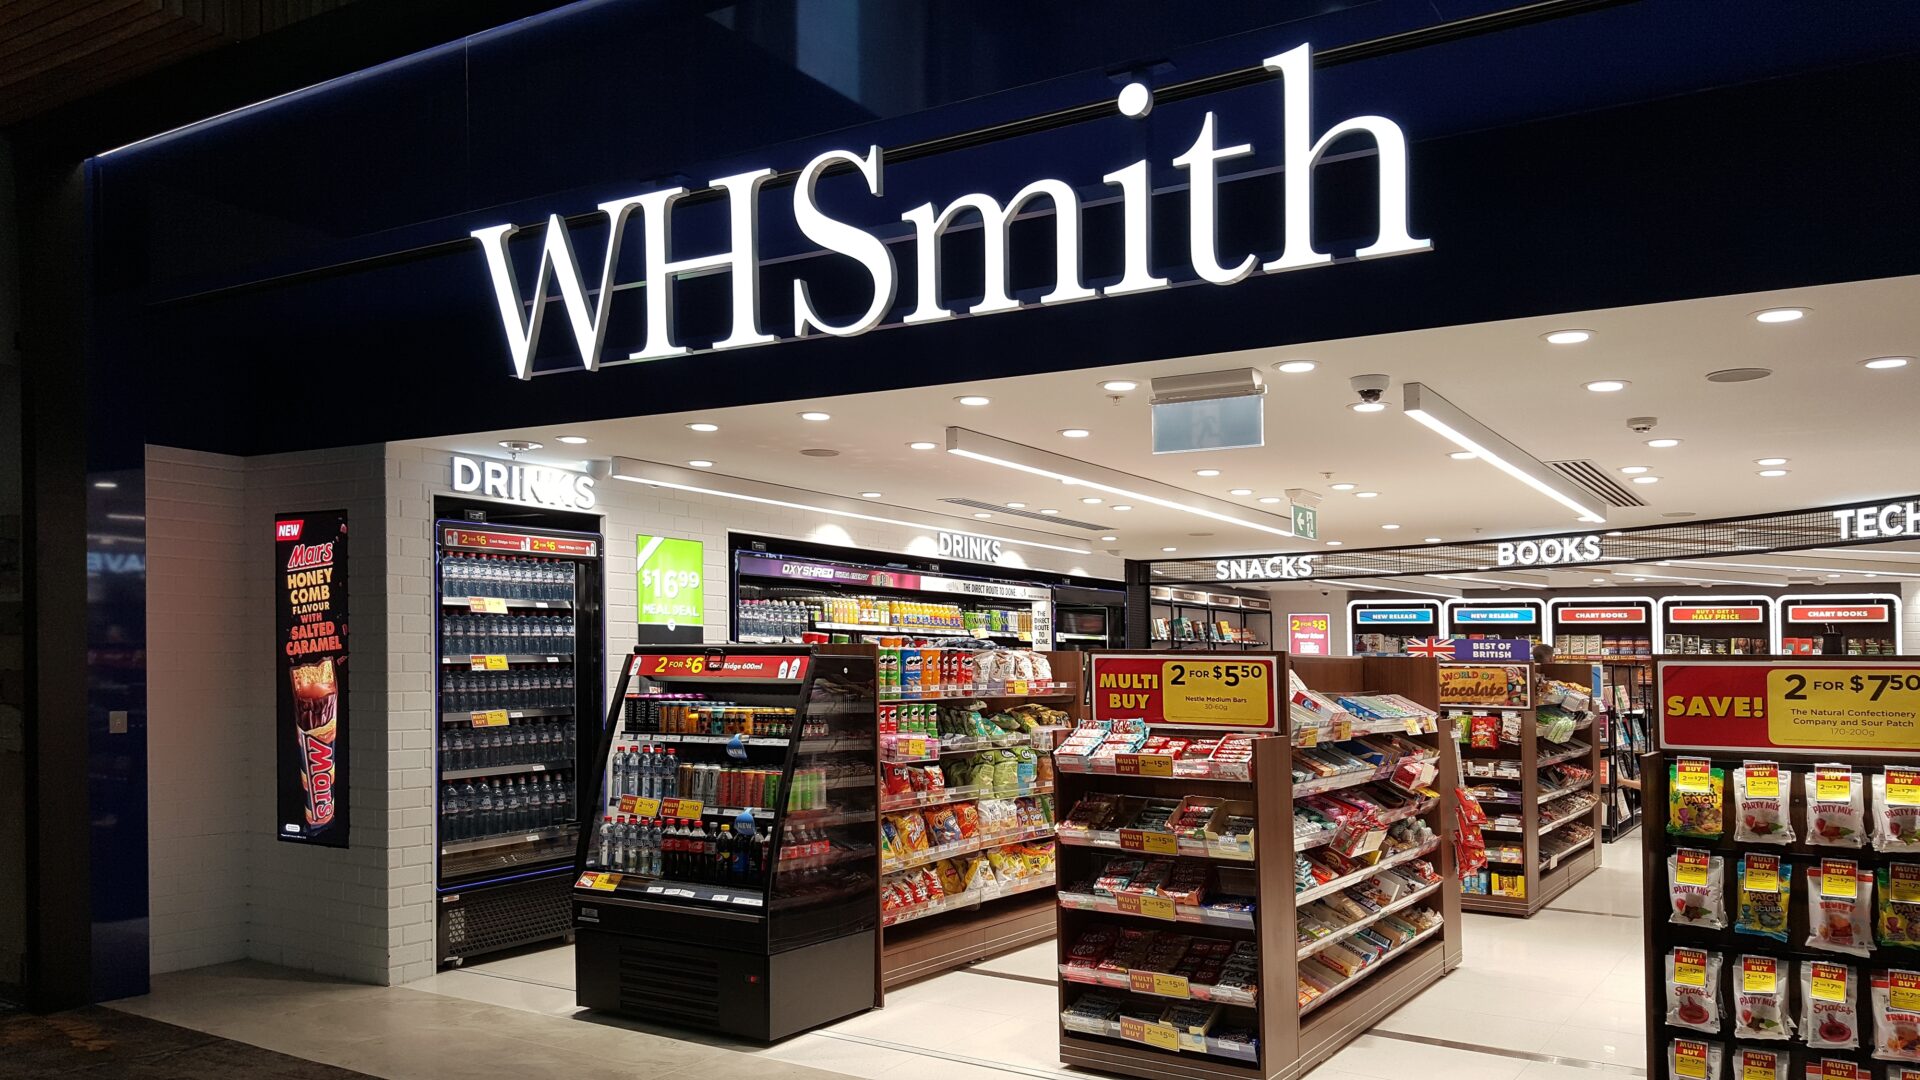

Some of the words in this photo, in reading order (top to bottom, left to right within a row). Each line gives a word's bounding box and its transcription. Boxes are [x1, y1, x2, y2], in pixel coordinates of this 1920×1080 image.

[470, 42, 1434, 380] WHSmith
[451, 456, 596, 509] DRINKS
[279, 524, 300, 536] NEW
[462, 534, 468, 544] 2
[533, 541, 540, 549] 2
[938, 532, 1001, 563] DRINKS
[1498, 535, 1602, 565] BOOKS
[288, 542, 333, 569] Mars
[782, 564, 834, 579] OXYSHRED
[1216, 556, 1313, 580] SNACKS
[287, 568, 333, 589] HONEY
[963, 583, 971, 592] THE
[971, 583, 985, 594] DIRECT
[986, 585, 999, 595] ROUTE
[1000, 586, 1004, 595] TO
[291, 586, 330, 605] COMB
[293, 602, 330, 615] FLAVOUR
[643, 604, 670, 616] MEAL
[672, 605, 699, 617] DEAL
[301, 613, 322, 624] WITH
[291, 621, 335, 640] SALTED
[1292, 620, 1300, 631] 2
[1312, 620, 1327, 631] $8
[286, 636, 342, 656] CARAMEL
[1473, 642, 1495, 650] BEST
[1497, 642, 1512, 650] OF
[1473, 651, 1512, 659] BRITISH
[655, 656, 668, 673] 2
[669, 661, 683, 669] FOR
[685, 657, 704, 674] $6
[723, 662, 741, 671] Ridge
[742, 662, 763, 670] 600ml
[1170, 664, 1186, 686] 2
[1189, 670, 1209, 678] FOR
[1442, 671, 1479, 681] WORLD
[1482, 672, 1495, 680] OF
[1100, 674, 1159, 689] MULTI
[1784, 674, 1807, 700] 2
[1814, 681, 1844, 691] FOR
[1109, 694, 1150, 709] BUY
[1667, 696, 1765, 719] SAVE!
[1791, 708, 1807, 717] The
[1810, 709, 1845, 717] Natural
[1847, 709, 1916, 719] Confectionery
[1793, 718, 1838, 727] Company
[1840, 718, 1859, 726] and
[1886, 719, 1914, 727] Patch
[1831, 728, 1875, 737] 170-200g
[729, 748, 743, 756] NEW
[307, 735, 333, 819] Mars
[1684, 795, 1717, 804] PATCH
[1742, 801, 1765, 811] PARTY
[1765, 802, 1781, 811] MIX
[1813, 805, 1837, 814] PARTY
[1838, 806, 1854, 816] MIX
[1884, 809, 1910, 819] PARTY
[1121, 833, 1143, 842] MULTI
[1124, 840, 1140, 848] BUY
[1682, 850, 1705, 859] MULTI
[1673, 886, 1696, 894] PARTY
[1696, 887, 1711, 897] MIX
[1118, 896, 1140, 905] MULTI
[1750, 893, 1781, 902] PATCH
[1121, 903, 1137, 911] BUY
[1679, 950, 1703, 958] MULTI
[1817, 965, 1842, 973] MULTI
[1131, 975, 1153, 983] MULTI
[1740, 996, 1762, 1006] PARTY
[1762, 998, 1777, 1008] MIX
[1813, 1003, 1854, 1015] Snakes
[1122, 1022, 1144, 1031] MULTI
[1125, 1029, 1141, 1037] BUY
[1680, 1042, 1703, 1050] MULTI
[1747, 1053, 1772, 1061] MULTI
[1827, 1062, 1853, 1071] MULTI
[1831, 1069, 1848, 1077] BUY
